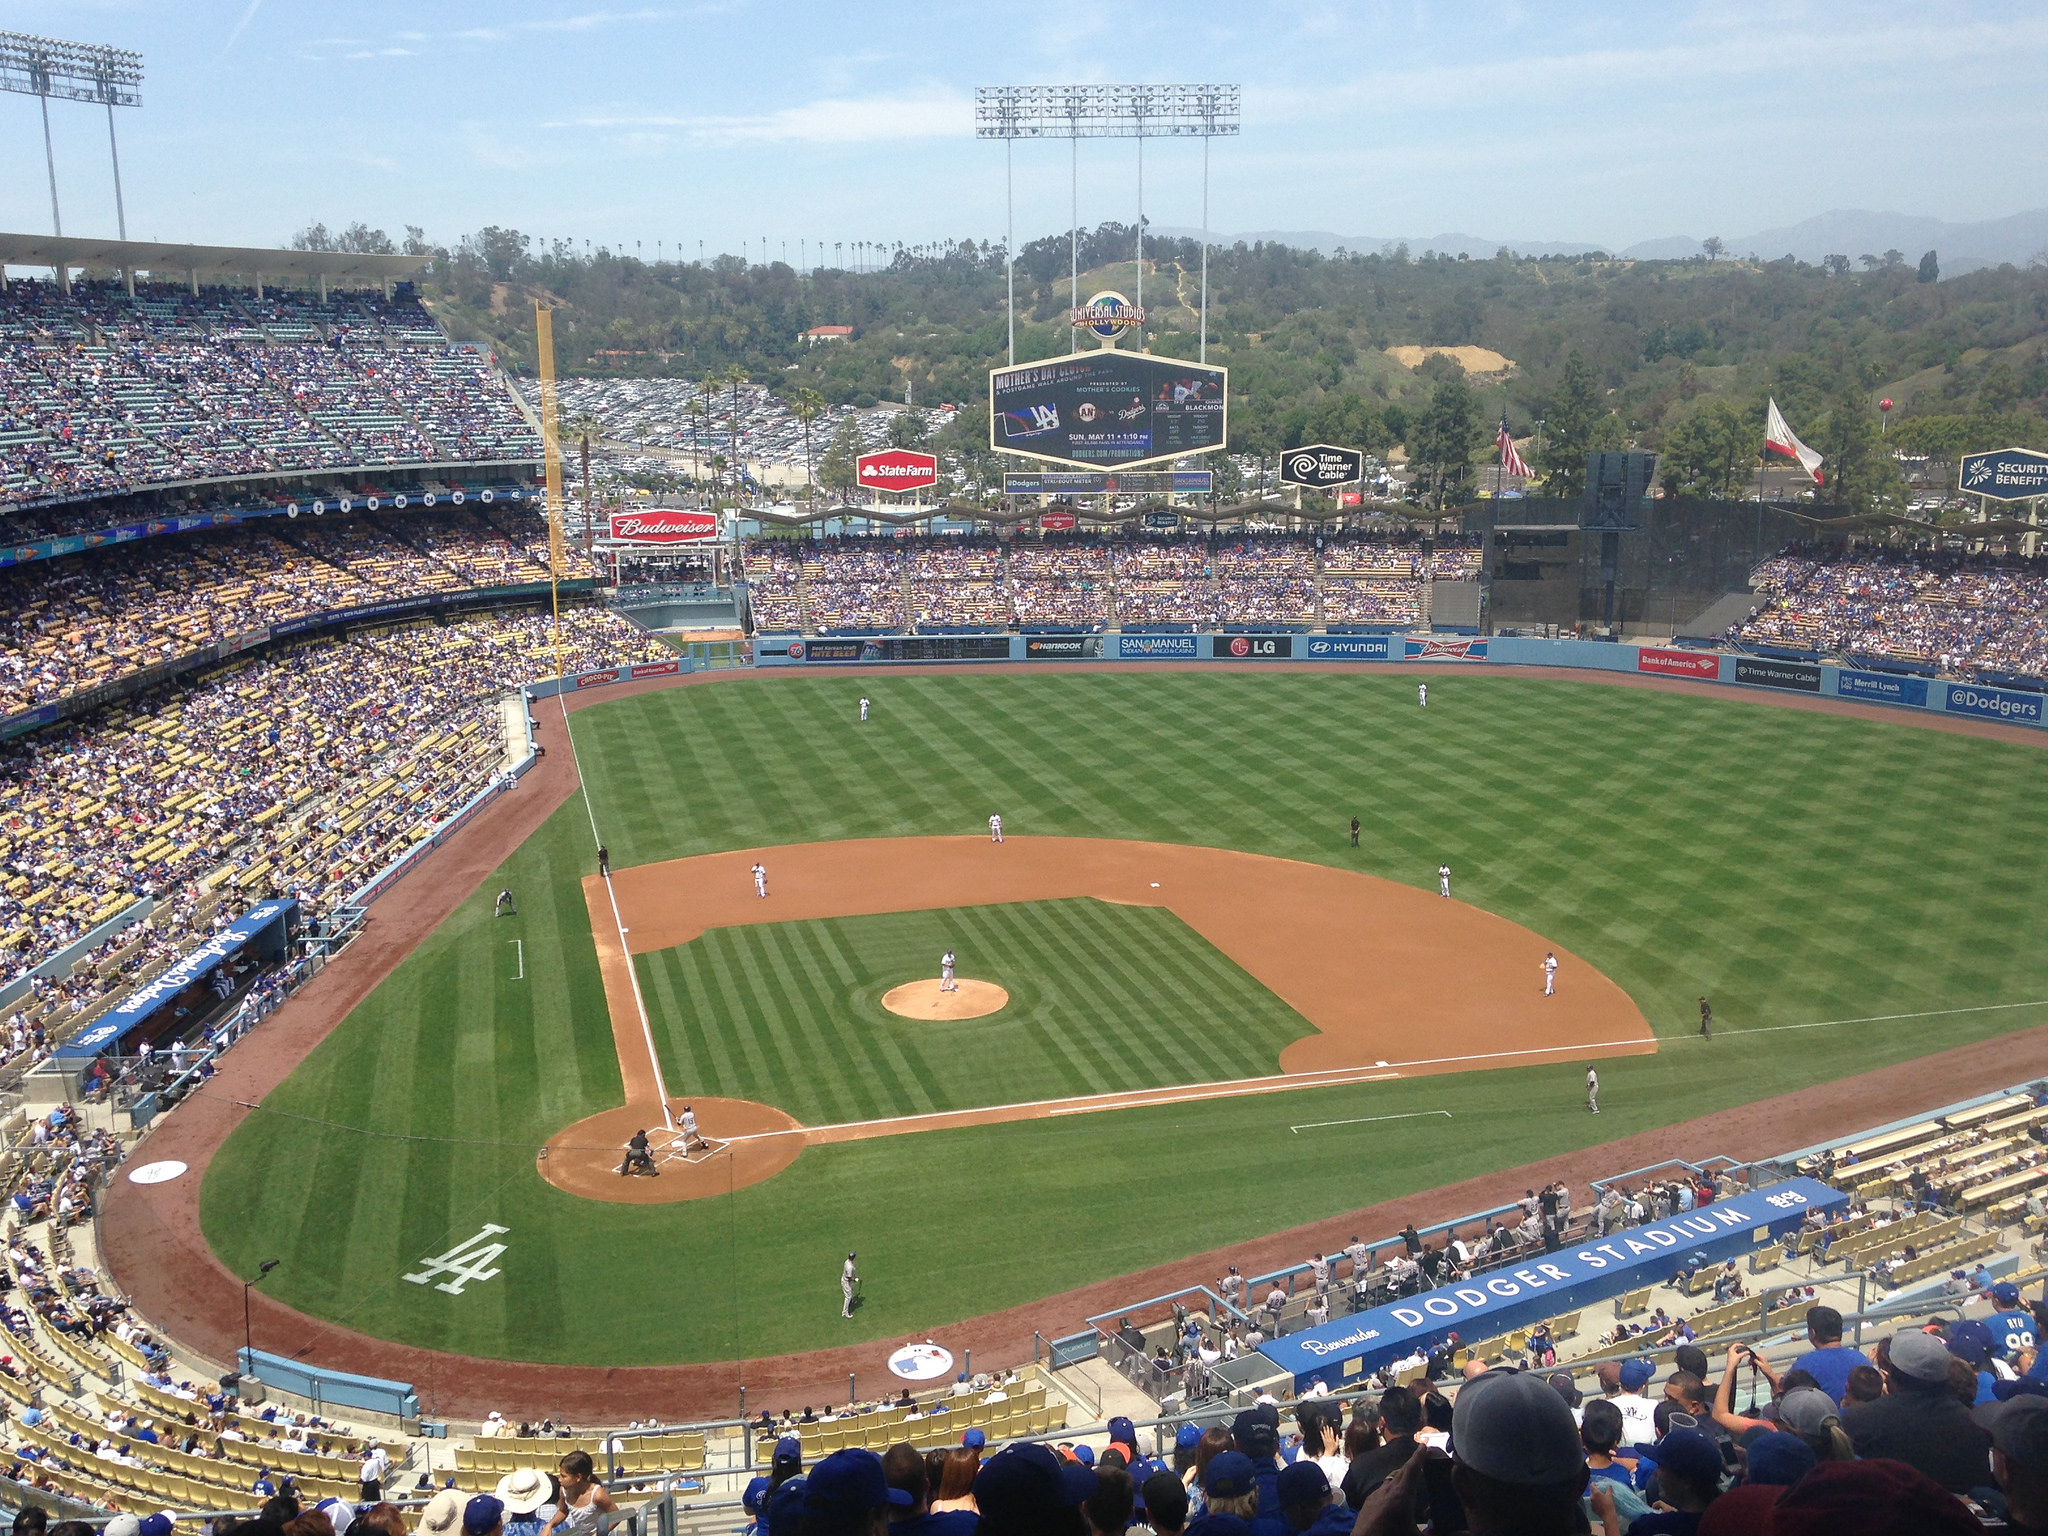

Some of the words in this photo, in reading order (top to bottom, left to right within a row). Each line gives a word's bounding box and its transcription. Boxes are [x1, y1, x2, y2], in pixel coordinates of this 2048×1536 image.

[1071, 306, 1114, 321] UNIVERSAL
[1115, 305, 1145, 320] STUDIOS
[996, 369, 1039, 390] MOTHER'S
[1041, 366, 1057, 381] DAY
[1002, 383, 1036, 394] POSTGAME
[1037, 380, 1054, 388] WALK
[1056, 375, 1083, 384] AROUND
[1118, 404, 1146, 421] Dodgers
[1319, 453, 1342, 463] Time
[1318, 462, 1352, 471] Warner
[1997, 461, 2048, 474] SECURITY
[1318, 471, 1345, 479] Cable
[1995, 474, 2044, 486] BENEFIT
[615, 518, 715, 536] Budweiser
[451, 591, 479, 601] HYUNDAI
[1121, 638, 1143, 648] SAN
[1151, 638, 1195, 648] MANUEL
[1253, 640, 1276, 654] LG
[1334, 643, 1387, 653] HYUNDAI
[1420, 644, 1470, 653] Budweiser
[791, 646, 802, 656] 76
[833, 650, 857, 658] BEER
[1642, 655, 1660, 664] Bank
[1660, 658, 1668, 666] of
[1667, 659, 1697, 669] America
[580, 673, 614, 686] CHOCO-PIE
[1748, 667, 1767, 676] Time
[1767, 669, 1794, 681] Warner
[1795, 672, 1817, 683] Cable
[1854, 678, 1878, 688] Merrill
[1878, 682, 1900, 692] Lynch
[1952, 690, 2037, 716] @Dodgers
[115, 974, 190, 1014] Dodgers
[402, 1223, 510, 1295] LA
[1357, 1250, 1365, 1259] 52
[1390, 1264, 1572, 1328] DODGER
[1579, 1207, 1752, 1268] STADIUM
[2006, 1318, 2024, 1329] RYU
